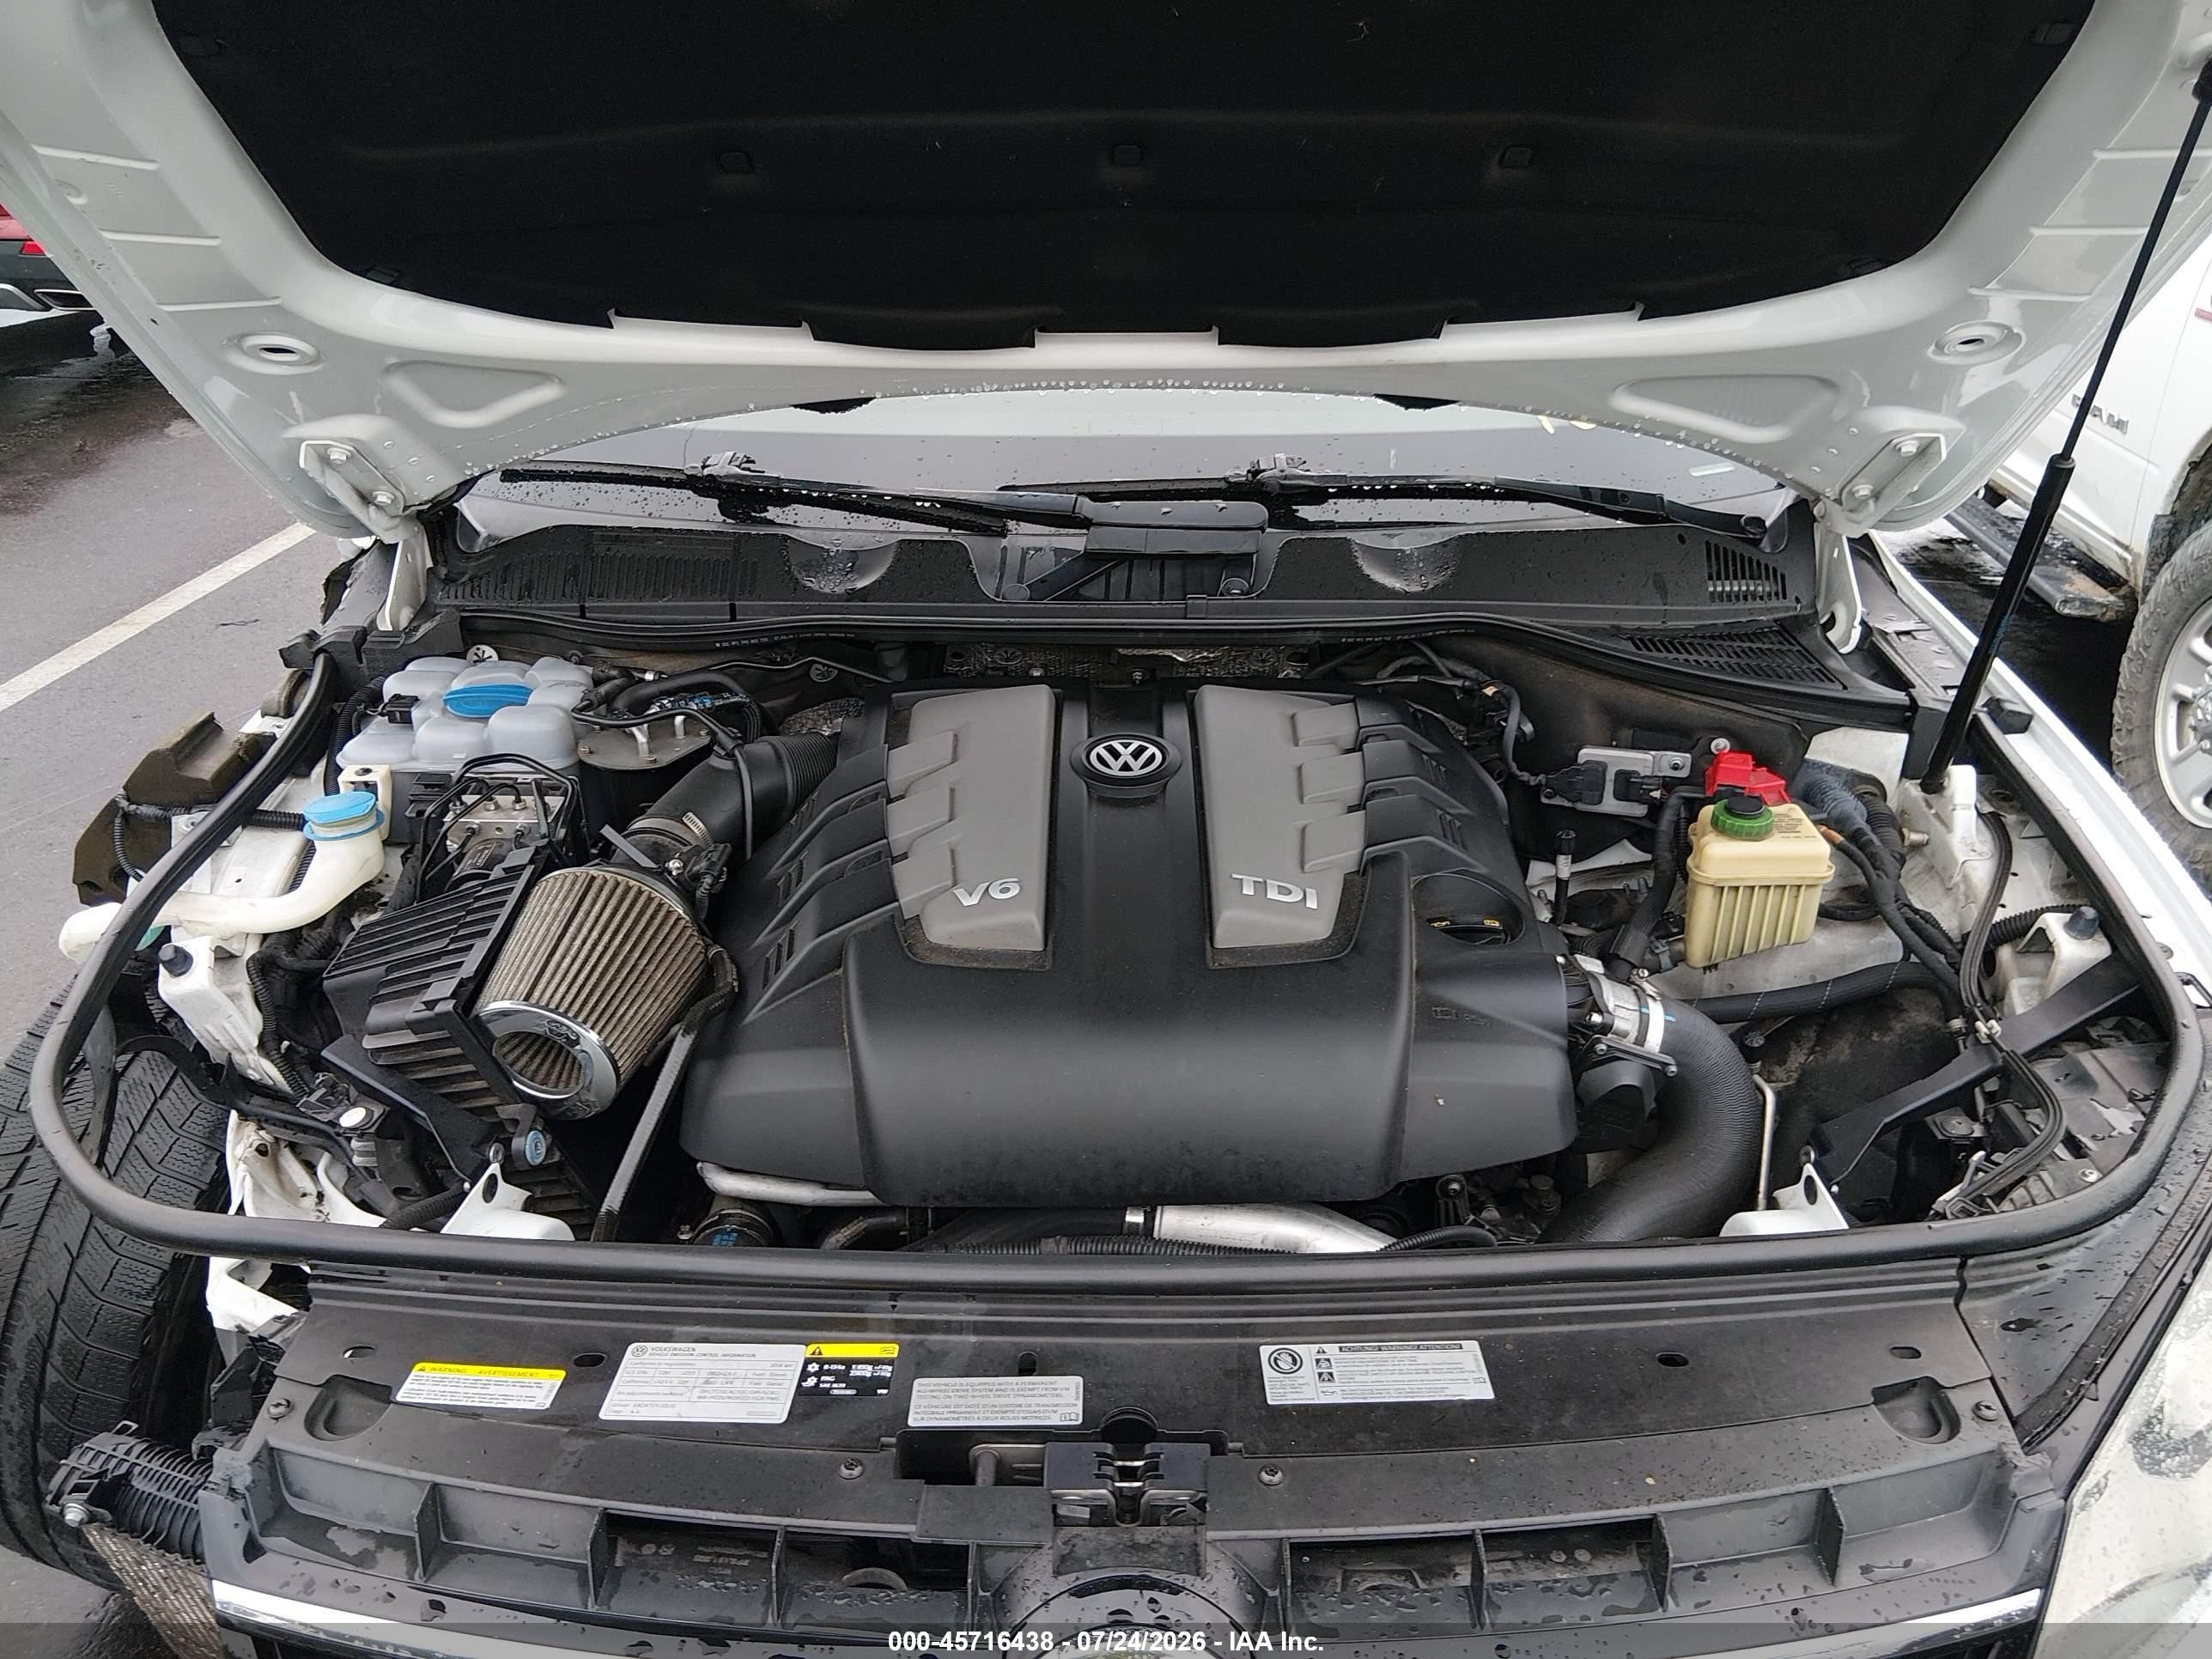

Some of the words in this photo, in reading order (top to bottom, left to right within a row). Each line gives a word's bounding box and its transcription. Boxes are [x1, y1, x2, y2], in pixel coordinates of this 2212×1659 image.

[1090, 739, 1162, 776] VW
[951, 877, 1020, 907] V6
[1231, 873, 1318, 909] TDI
[429, 1366, 467, 1375] WARNING
[477, 1369, 539, 1379] AVERTISSEMENT
